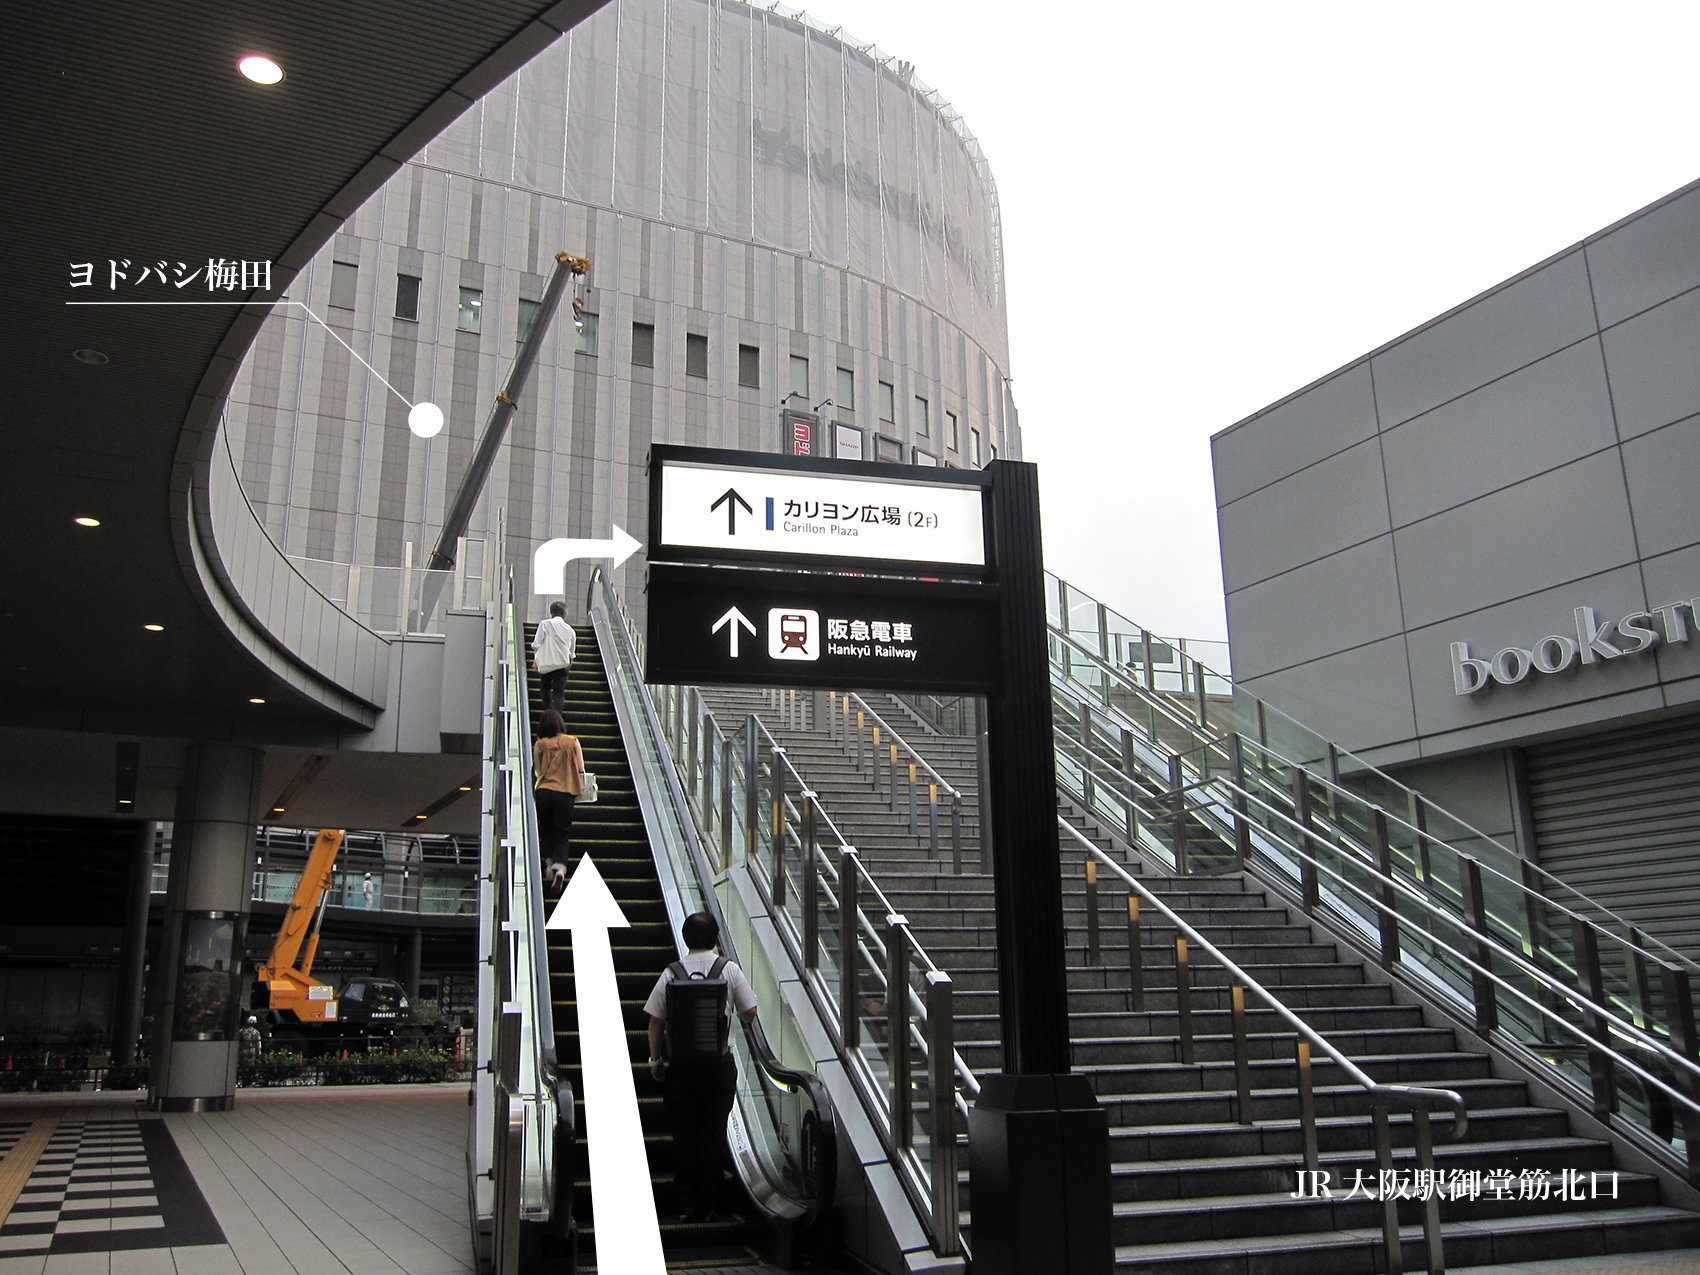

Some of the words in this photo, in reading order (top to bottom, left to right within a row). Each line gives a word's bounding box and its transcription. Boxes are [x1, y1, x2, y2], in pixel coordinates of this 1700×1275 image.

[783, 499, 901, 526] カリヨン広場
[783, 521, 826, 535] Carillon
[830, 524, 859, 537] Plaza
[827, 618, 913, 643] 阪急電車
[827, 642, 871, 659] Hankyū
[875, 645, 918, 661] Railway
